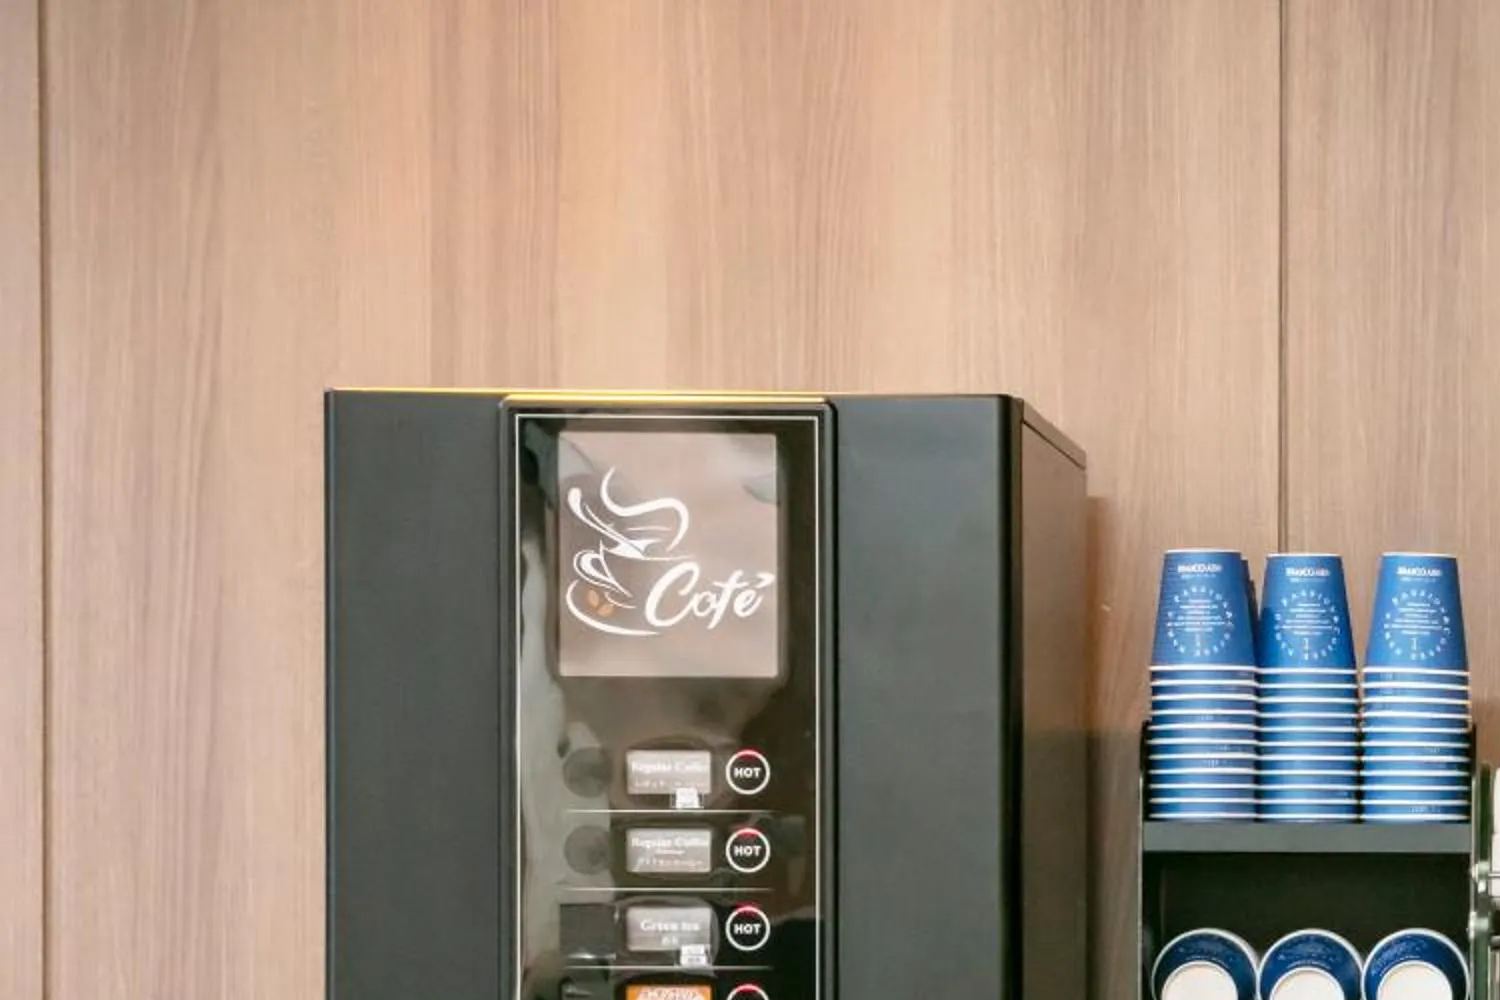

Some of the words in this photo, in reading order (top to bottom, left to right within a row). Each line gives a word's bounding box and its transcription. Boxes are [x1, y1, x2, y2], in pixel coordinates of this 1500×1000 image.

[645, 562, 775, 629] Café
[733, 767, 762, 778] HOT
[733, 845, 762, 856] HOT
[733, 923, 762, 934] HOT
